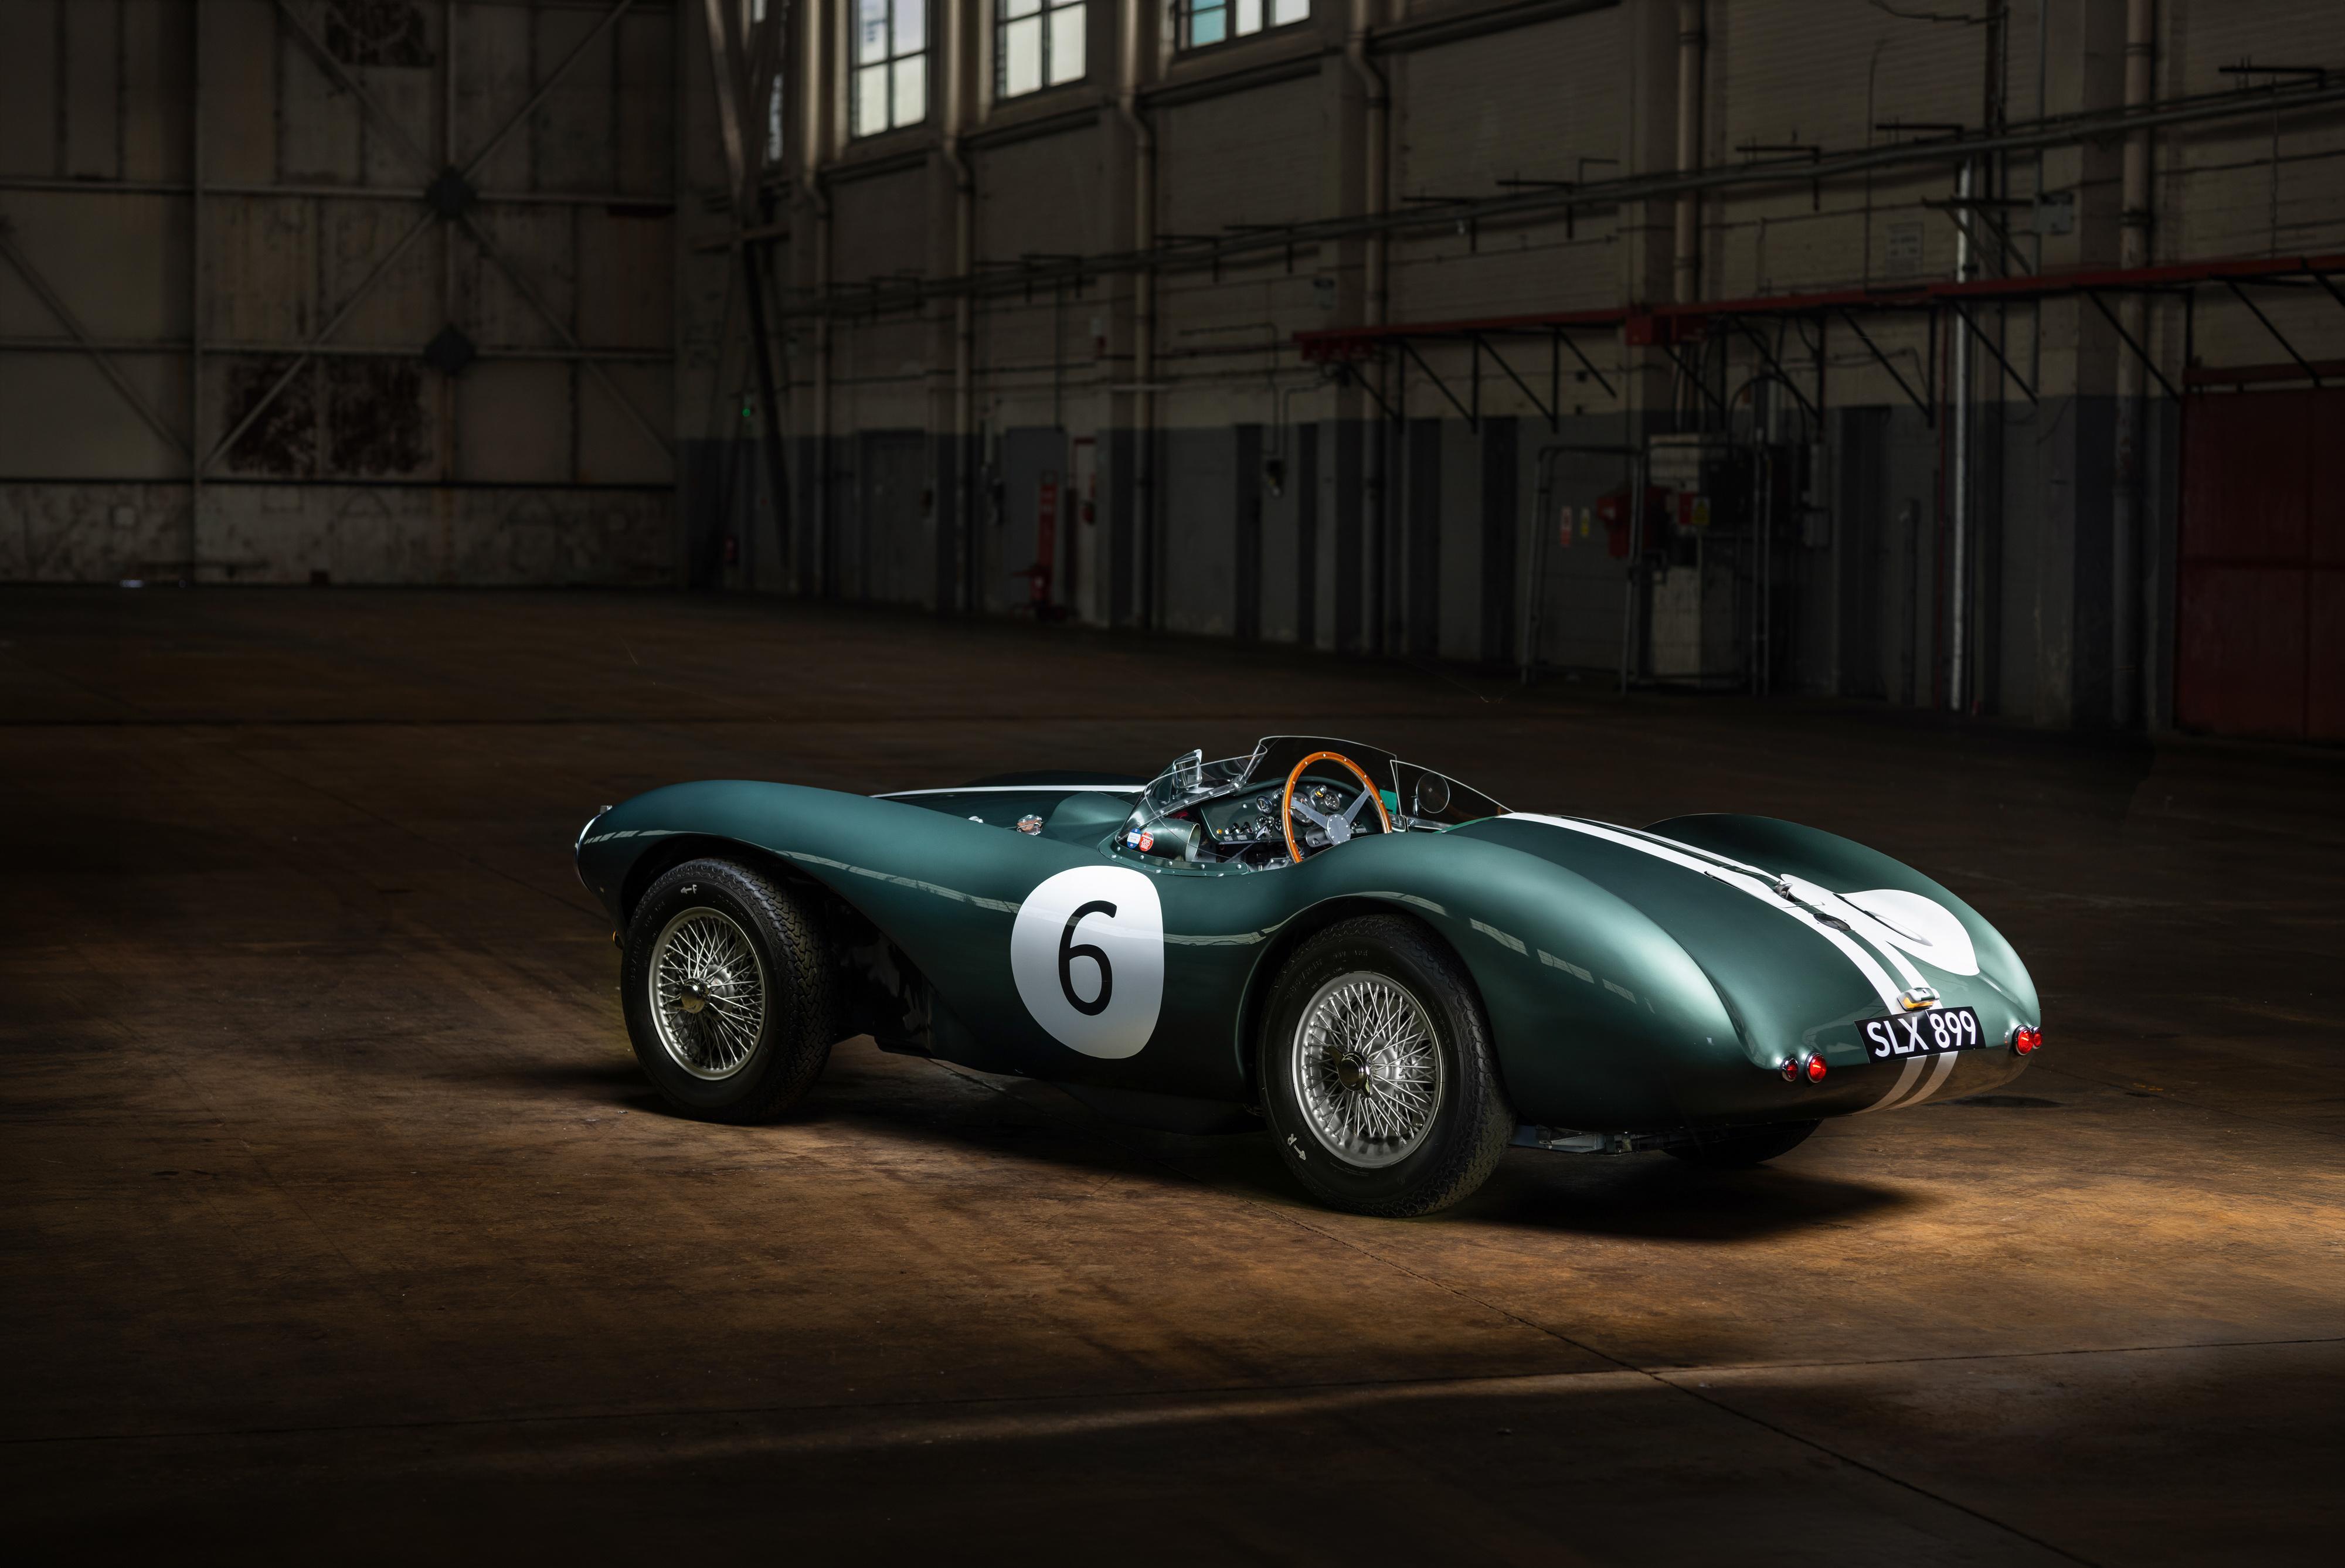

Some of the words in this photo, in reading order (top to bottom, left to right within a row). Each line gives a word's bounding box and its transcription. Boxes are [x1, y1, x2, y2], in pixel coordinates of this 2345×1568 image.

[1058, 900, 1117, 1016] 6
[1867, 1016, 1929, 1058] SLX
[1929, 1010, 1976, 1048] 899
